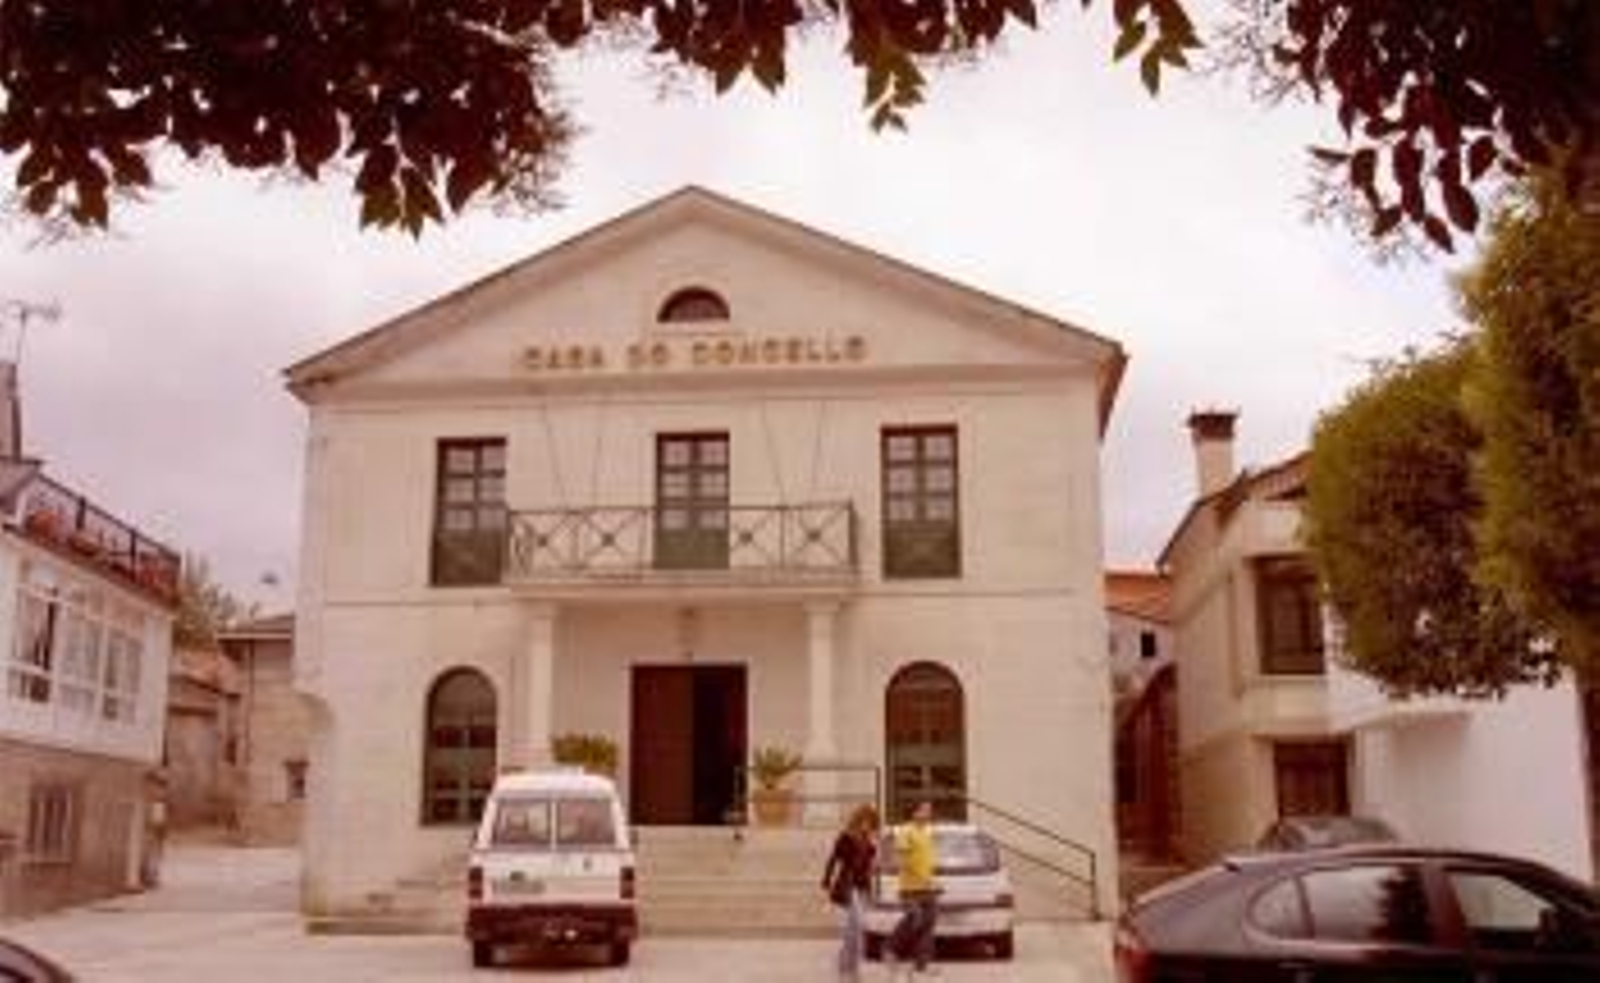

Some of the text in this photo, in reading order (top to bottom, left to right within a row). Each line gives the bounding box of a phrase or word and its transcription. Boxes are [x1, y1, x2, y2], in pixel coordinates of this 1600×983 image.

[524, 335, 866, 369] CASA DO CONCELLO
